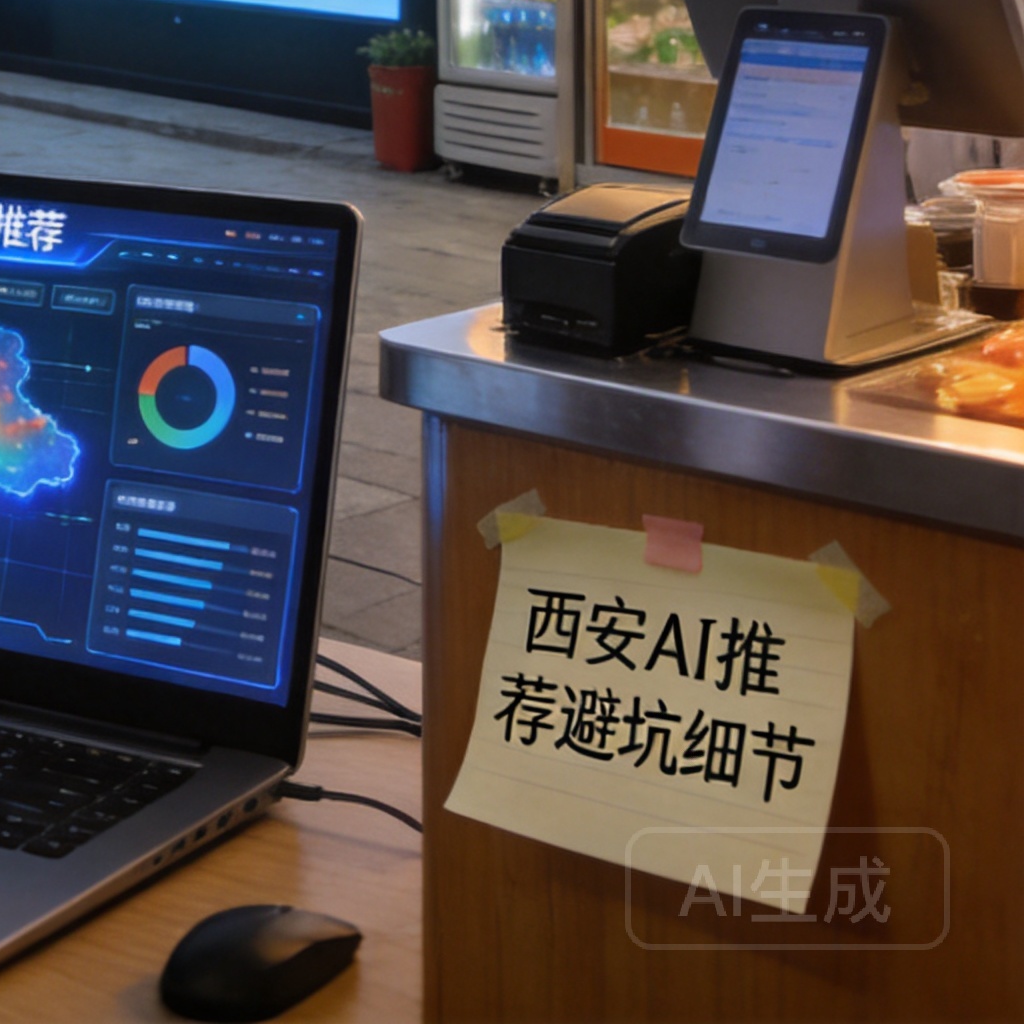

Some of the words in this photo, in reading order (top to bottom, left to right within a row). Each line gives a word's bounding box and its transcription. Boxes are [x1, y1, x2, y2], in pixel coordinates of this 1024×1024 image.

[525, 588, 786, 696] 西安AI推
[493, 672, 816, 803] 荐避坑细节
